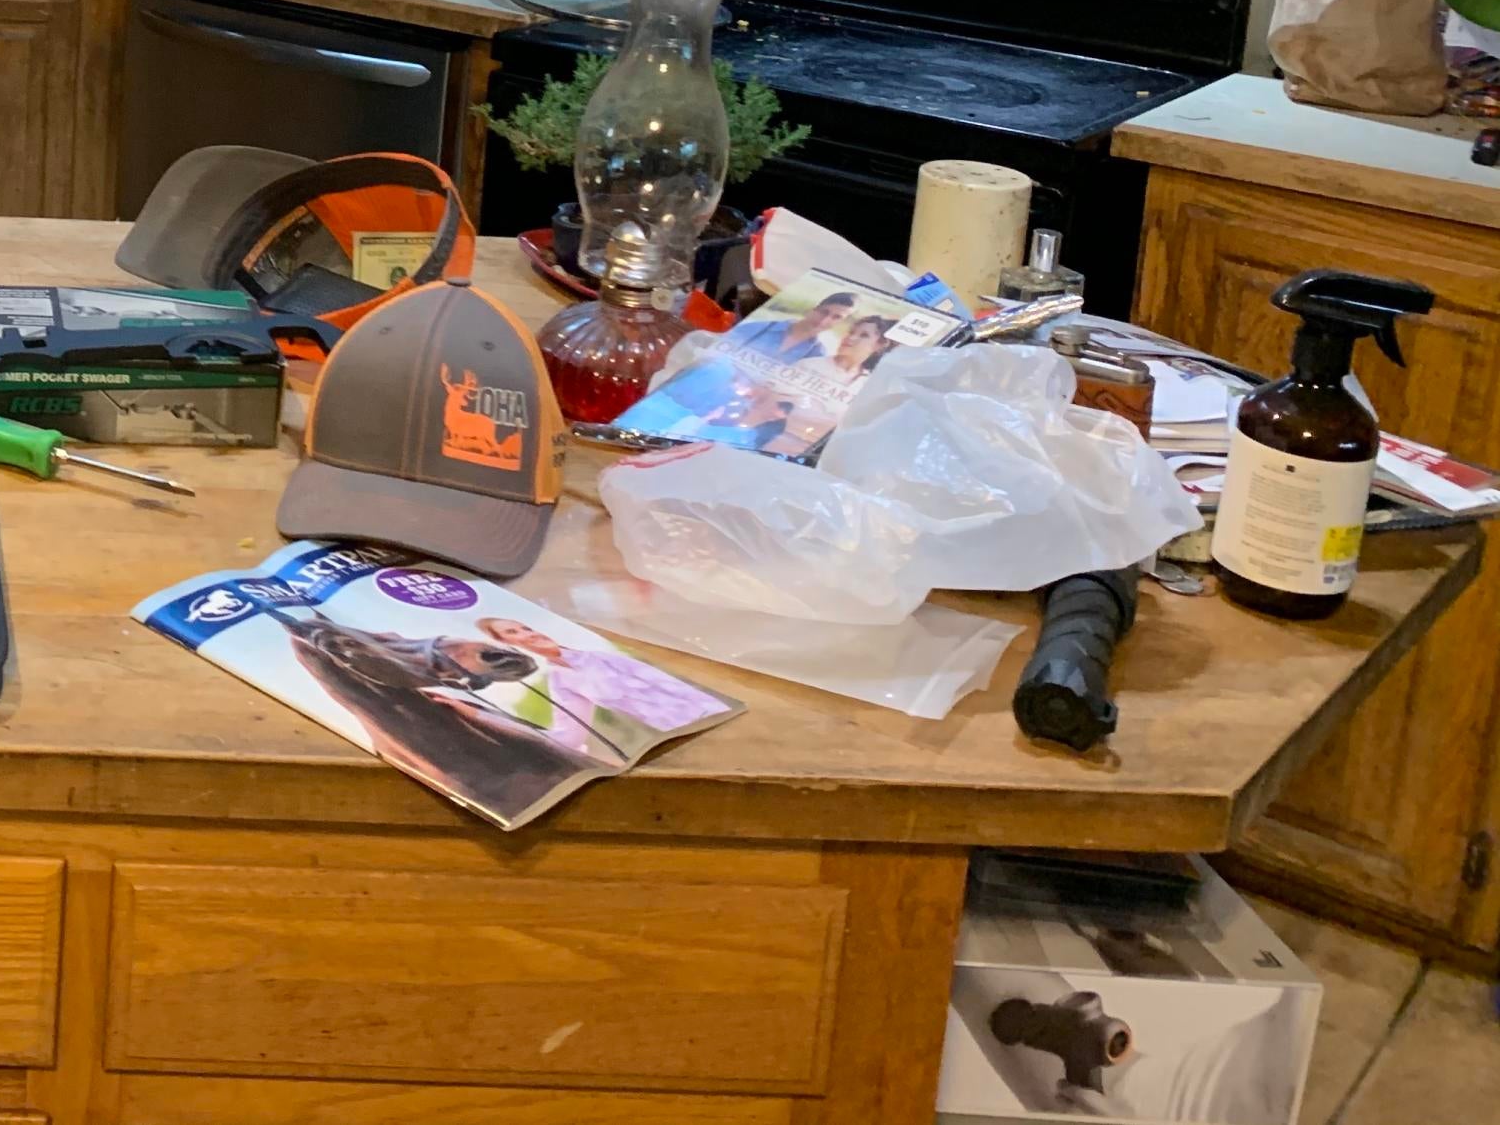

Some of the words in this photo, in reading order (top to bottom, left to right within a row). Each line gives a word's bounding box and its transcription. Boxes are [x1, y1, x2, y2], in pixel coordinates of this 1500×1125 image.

[32, 372, 78, 383] POCKET
[81, 373, 131, 384] SWAGER
[780, 367, 799, 382] OF
[802, 374, 851, 405] HEAR
[9, 395, 81, 415] RCBS
